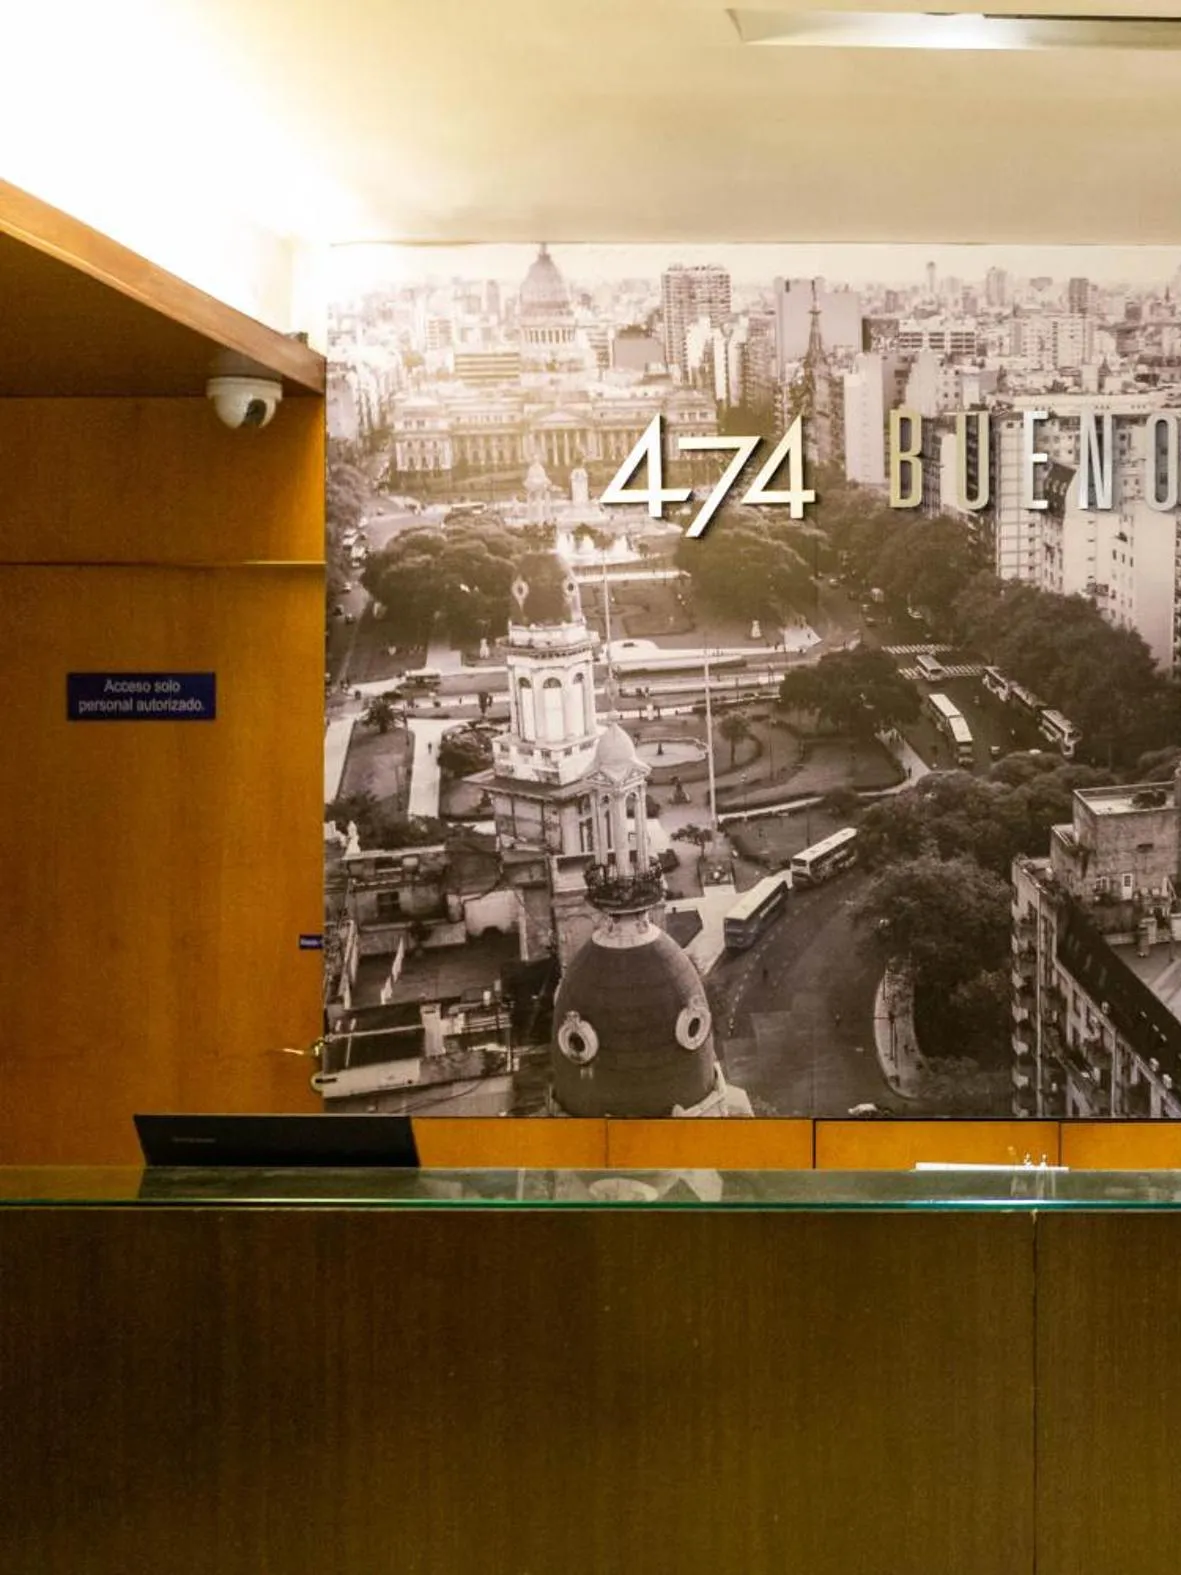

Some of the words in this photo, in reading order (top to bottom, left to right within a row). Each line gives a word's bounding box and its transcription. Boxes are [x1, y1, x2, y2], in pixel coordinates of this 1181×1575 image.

[598, 413, 817, 539] 474
[103, 677, 151, 693] Acceso
[154, 677, 181, 693] solo
[78, 697, 133, 714] personal
[136, 697, 205, 713] autorizado.
